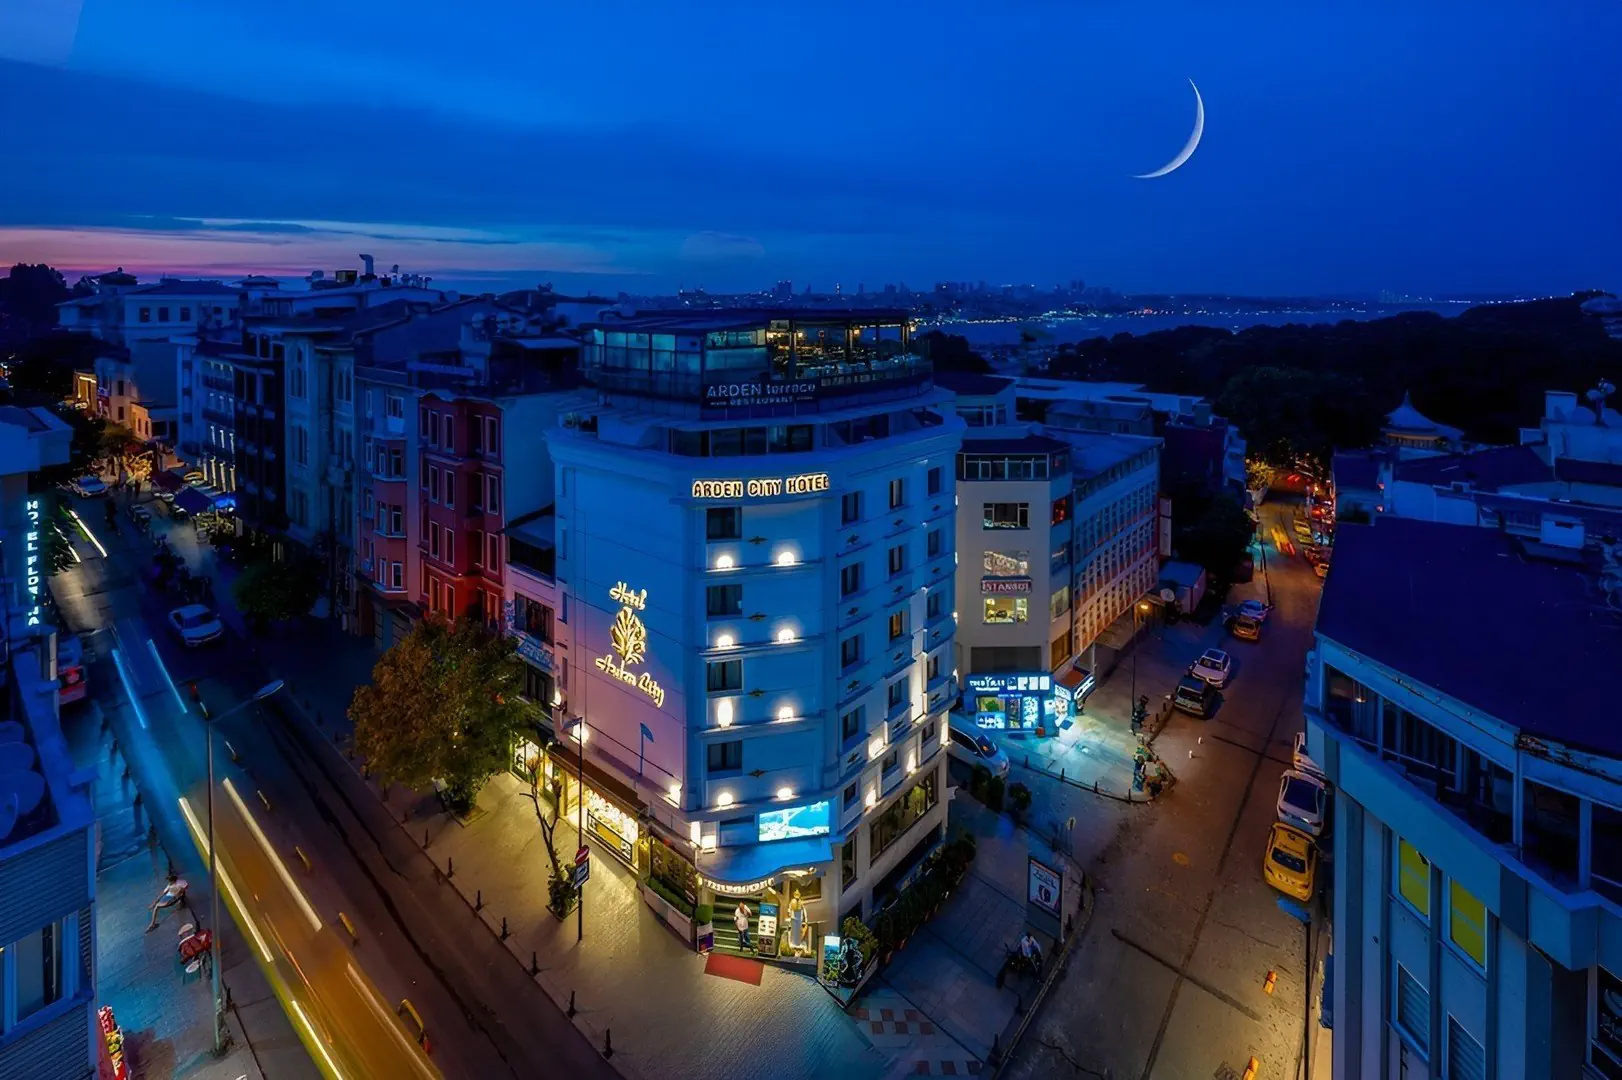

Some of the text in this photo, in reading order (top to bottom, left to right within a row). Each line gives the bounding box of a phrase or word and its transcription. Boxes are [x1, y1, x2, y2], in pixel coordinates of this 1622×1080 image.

[706, 384, 762, 398] ARDEN
[692, 473, 829, 498] ARDEN CITY HOTEL
